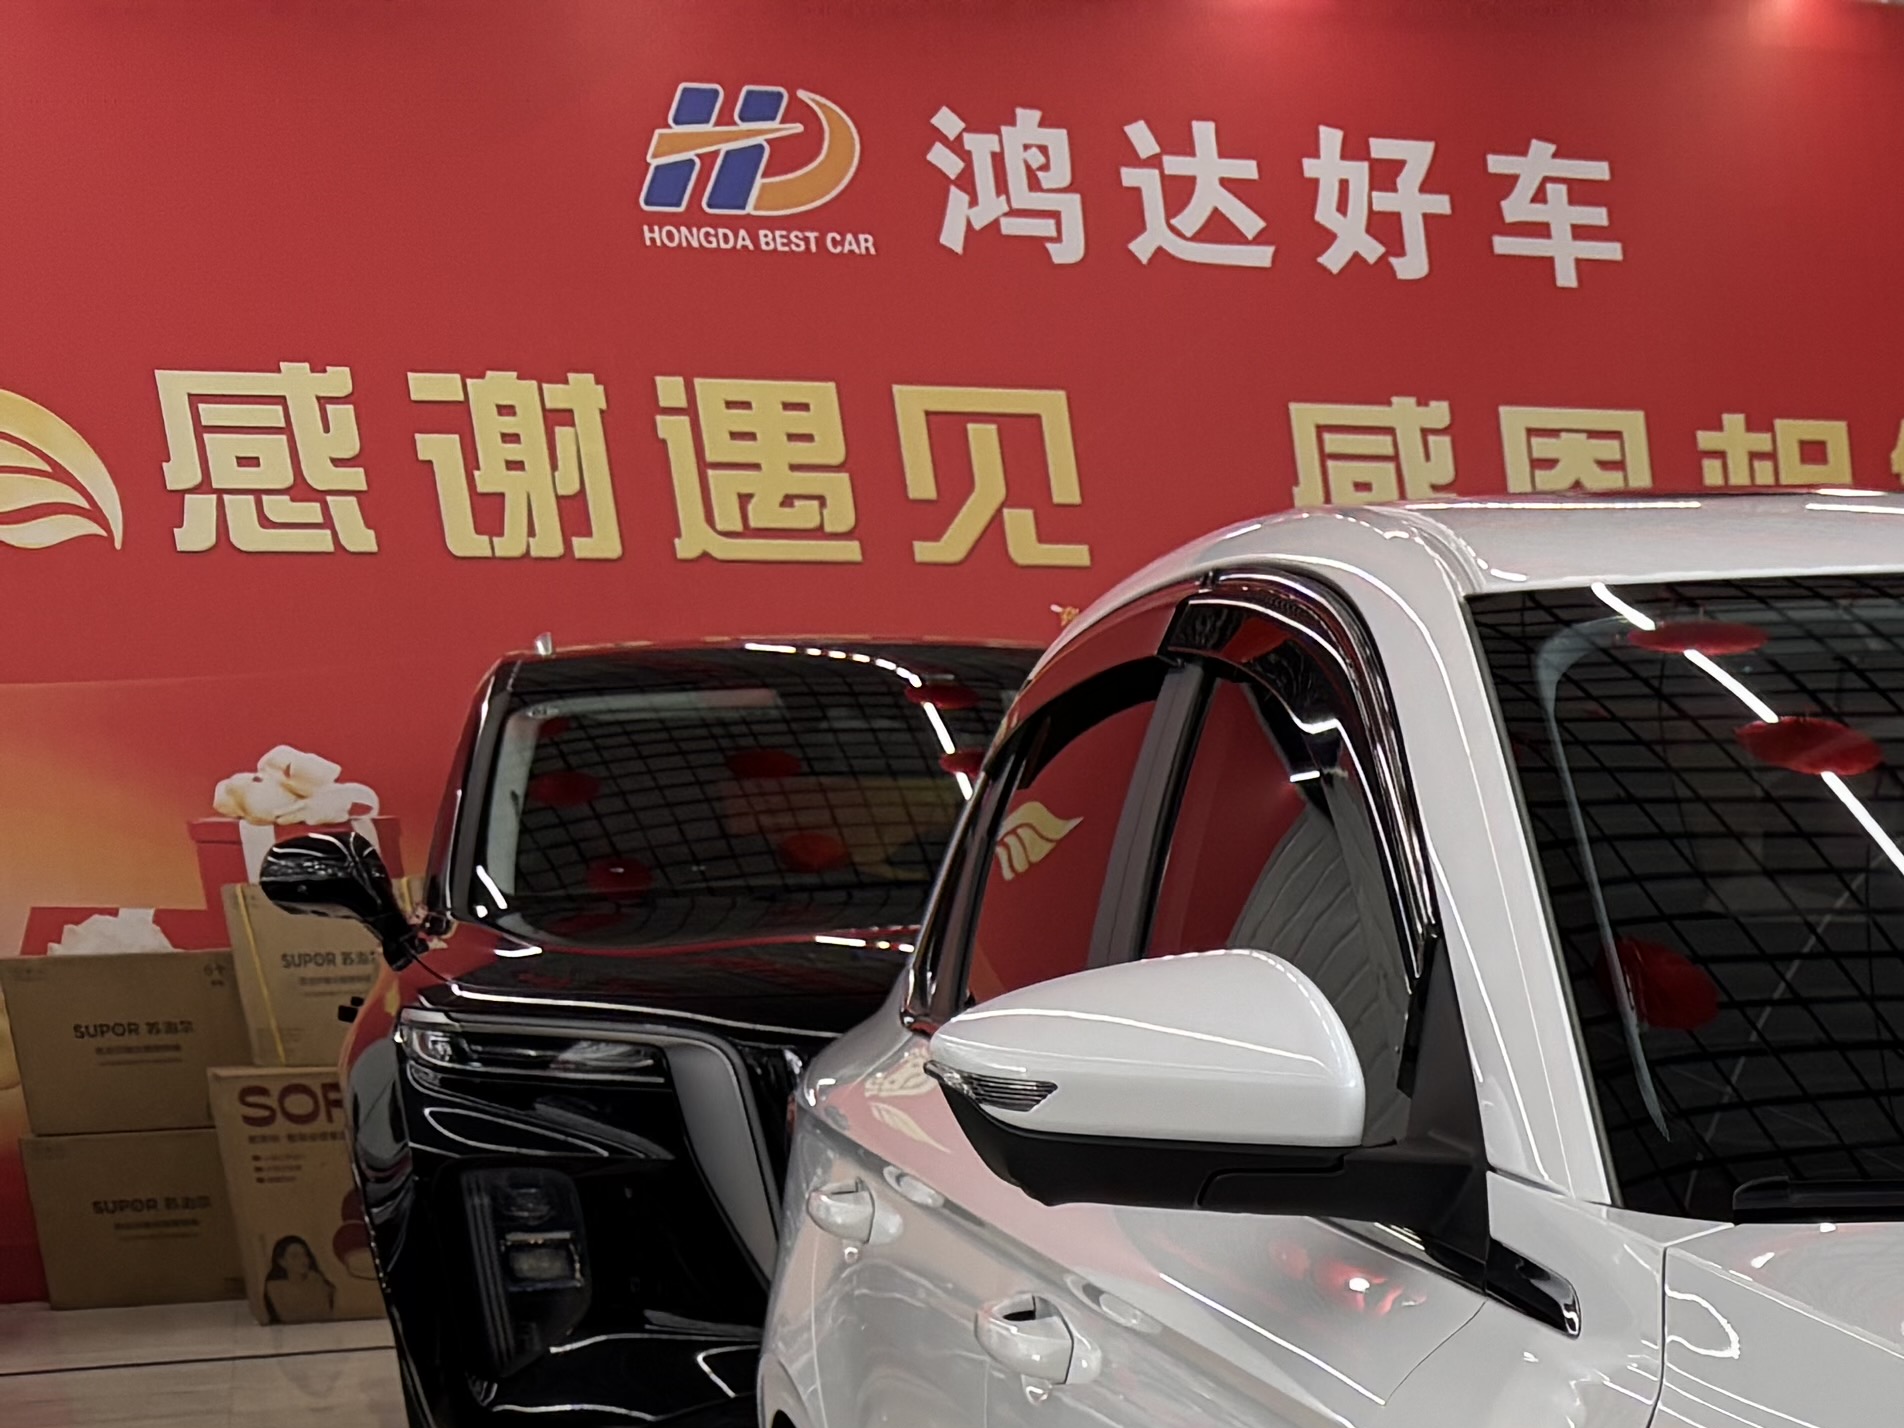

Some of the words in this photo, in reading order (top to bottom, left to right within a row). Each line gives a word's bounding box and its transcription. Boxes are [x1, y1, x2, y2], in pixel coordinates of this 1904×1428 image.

[926, 105, 1623, 288] 鸿达好车
[643, 225, 754, 251] HONGDA
[759, 229, 819, 253] BEST
[826, 232, 877, 255] CAR
[154, 361, 1090, 566] 感谢遇见
[281, 951, 336, 968] SUPOR
[73, 1022, 139, 1039] SUPOR
